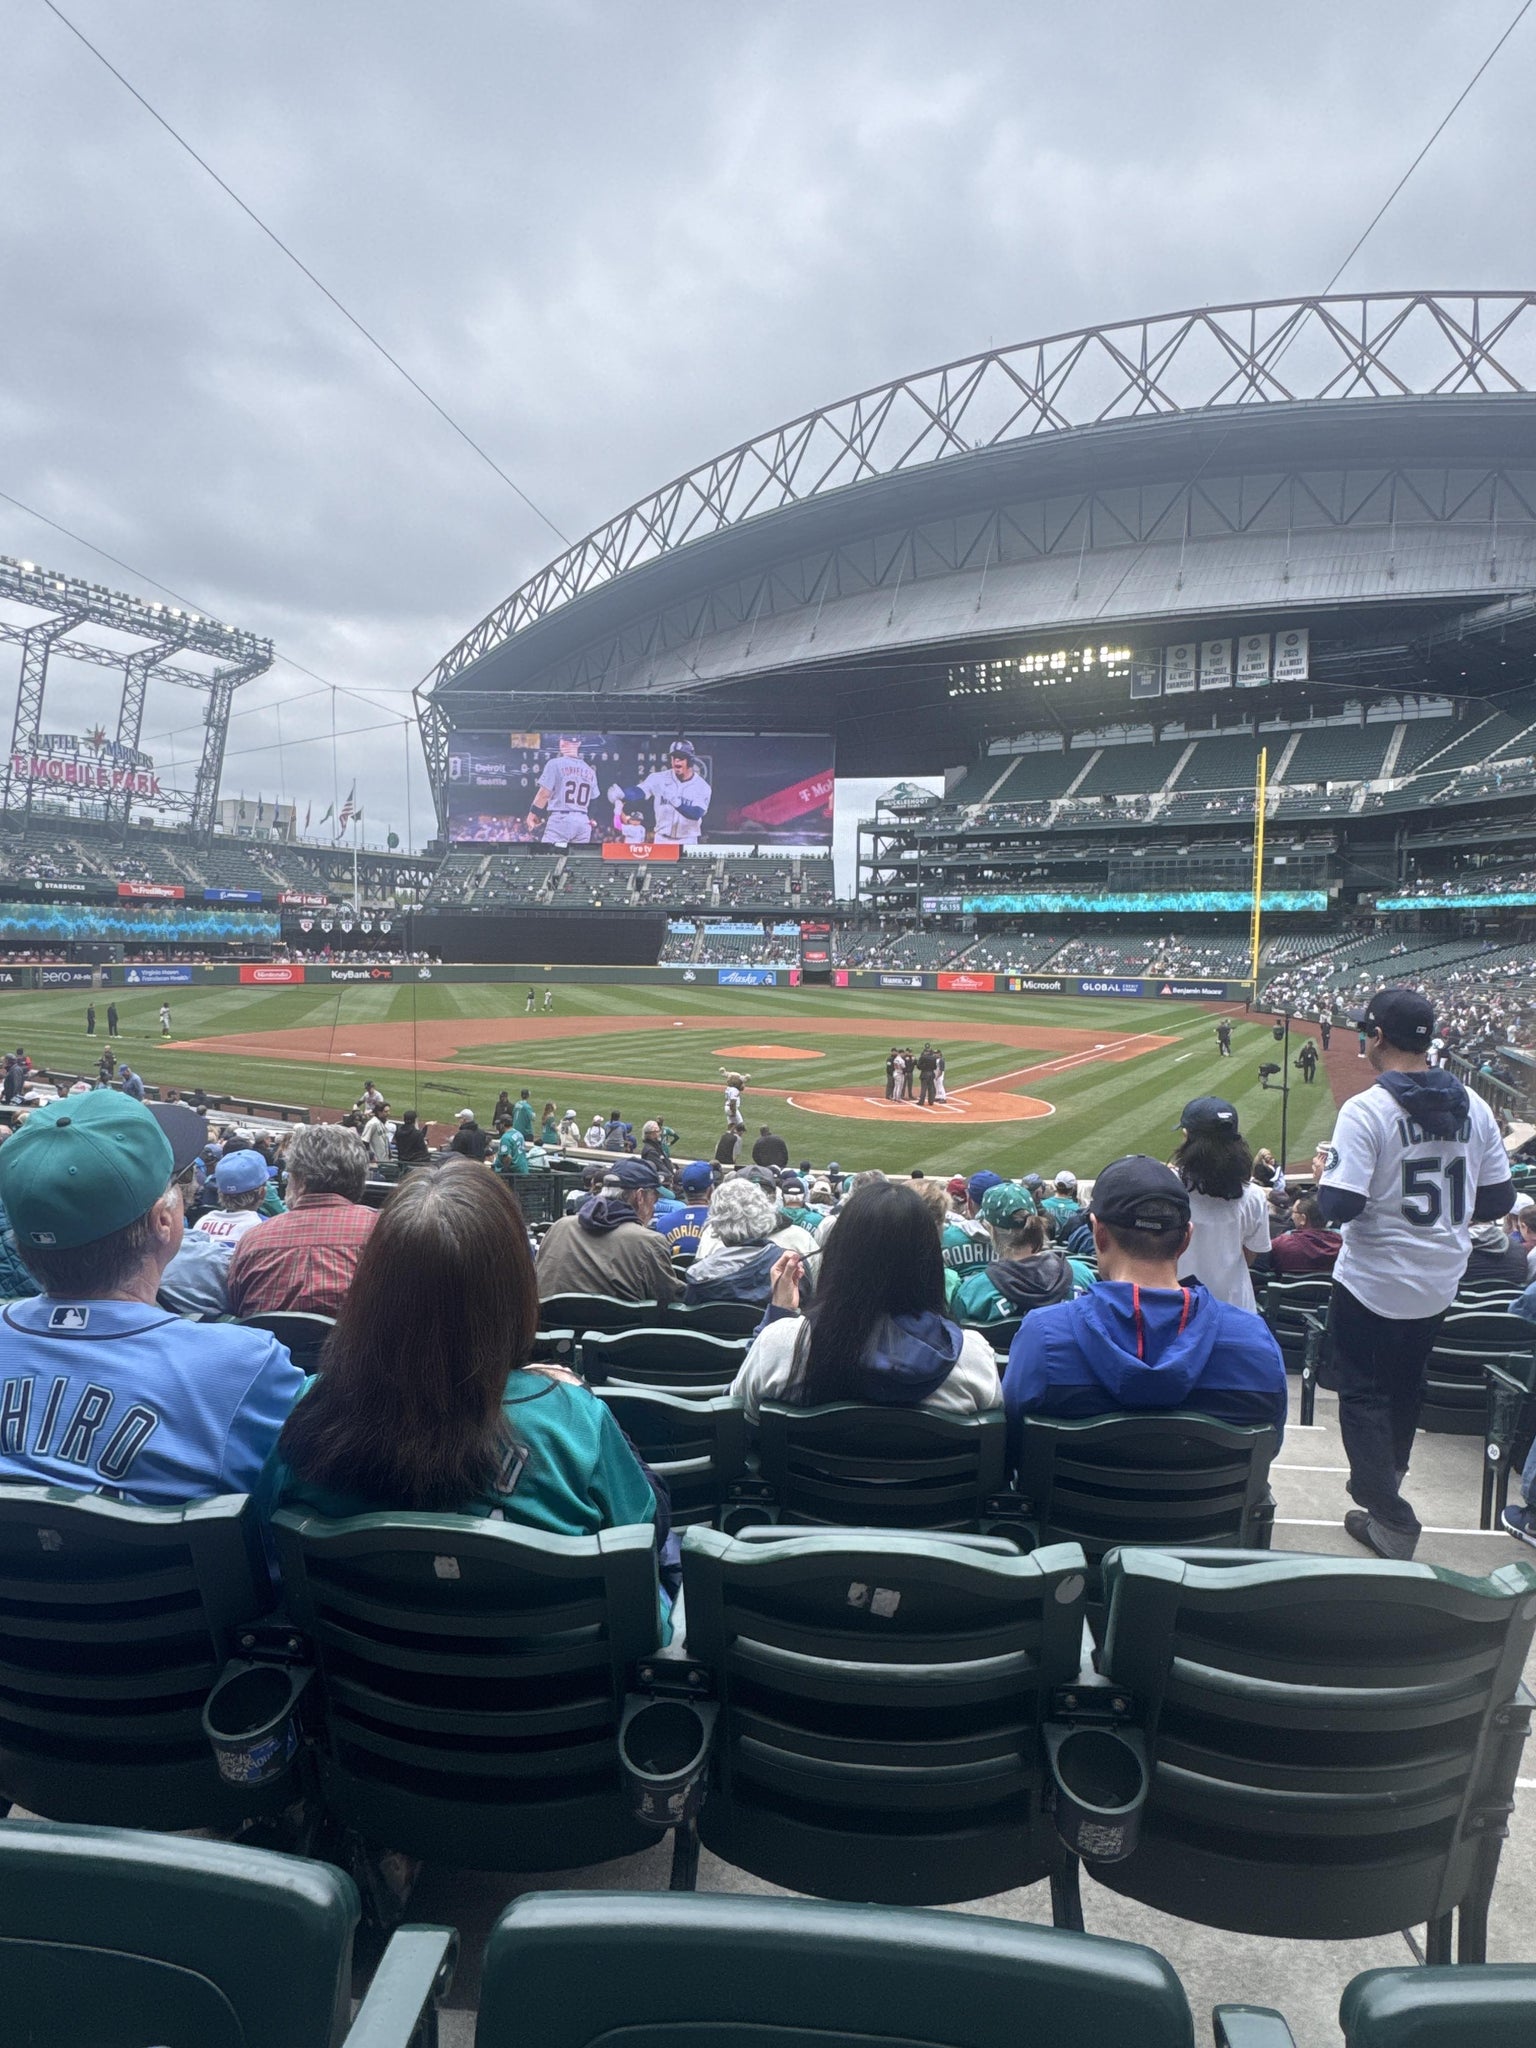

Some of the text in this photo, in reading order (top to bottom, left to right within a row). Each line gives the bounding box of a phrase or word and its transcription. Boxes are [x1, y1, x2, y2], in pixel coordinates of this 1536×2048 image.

[28, 733, 154, 770] SEATTLE MARINERS
[112, 770, 160, 795] PARK
[476, 776, 508, 786] Seattle
[564, 780, 591, 807] 20
[630, 845, 643, 853] fire
[45, 882, 86, 891] STARBUCKS
[331, 970, 371, 980] KeyBank
[722, 970, 758, 984] Alaska
[1023, 980, 1061, 990] Microsoft
[1082, 983, 1121, 992] GLOBAL
[1172, 987, 1223, 995] Benjamin Moore
[1396, 1116, 1472, 1148] ICO
[1401, 1156, 1467, 1227] 51
[201, 1221, 237, 1236] RILEY
[0, 1374, 160, 1480] HIRO
